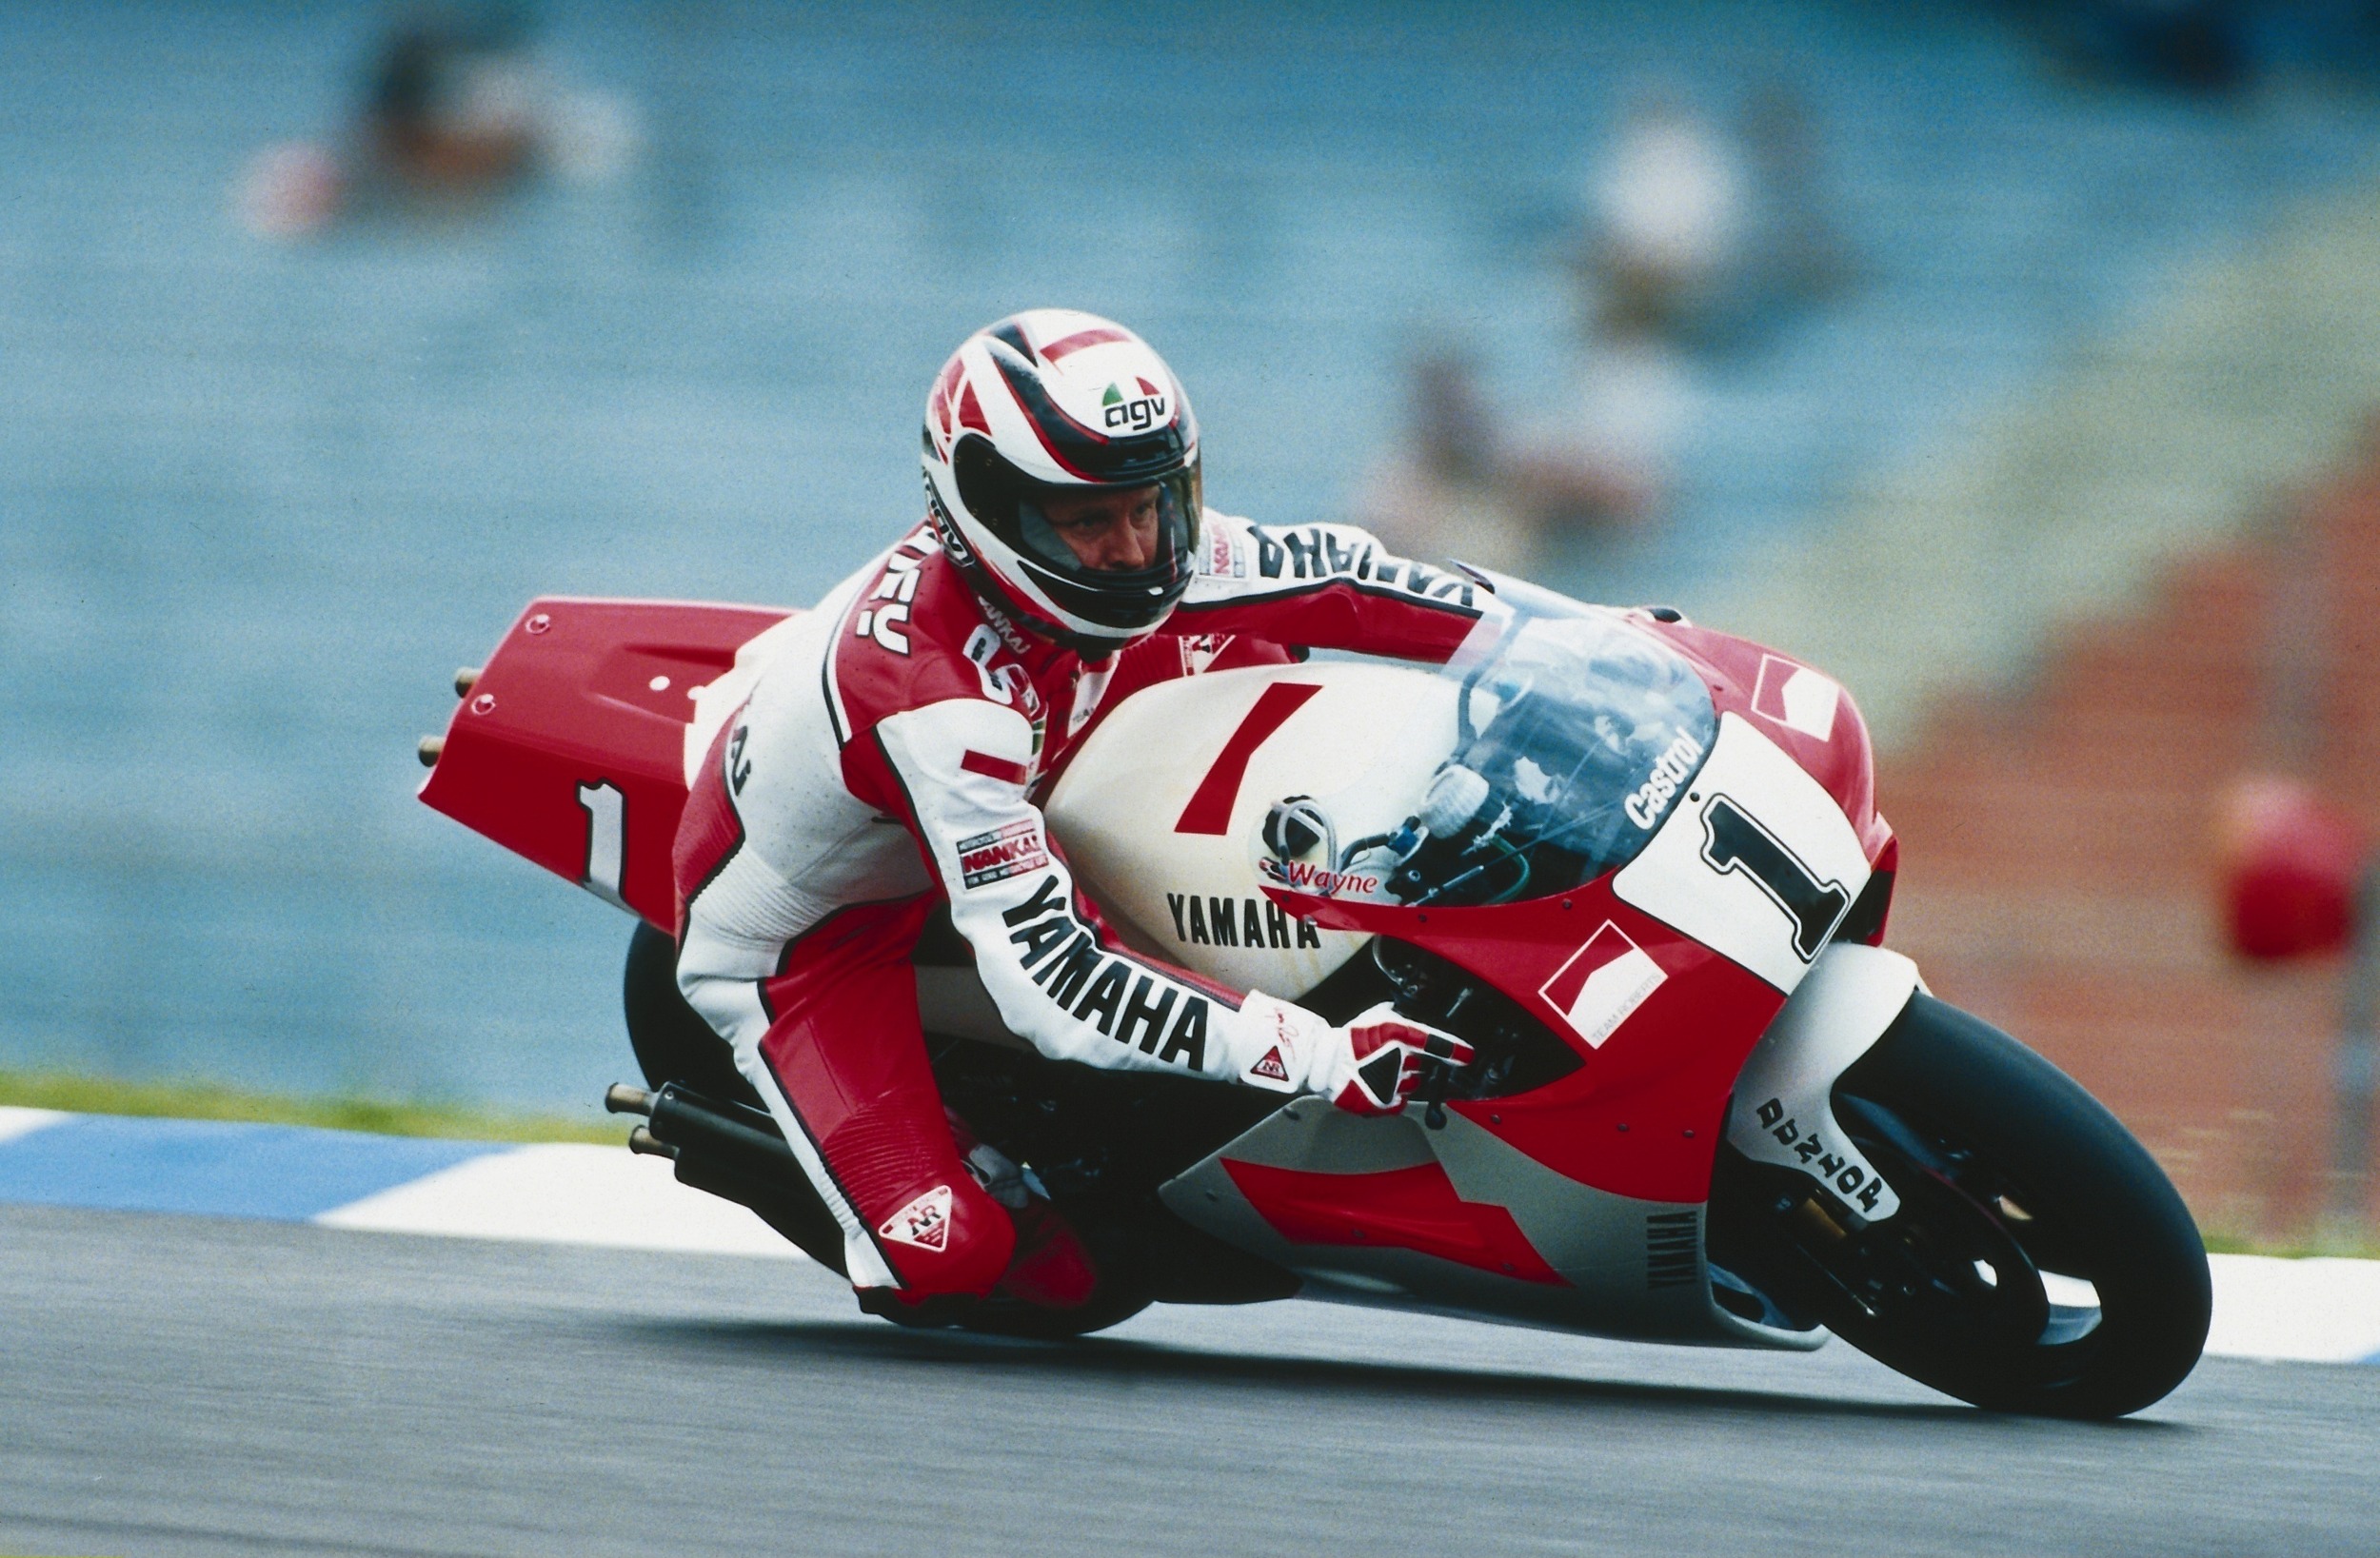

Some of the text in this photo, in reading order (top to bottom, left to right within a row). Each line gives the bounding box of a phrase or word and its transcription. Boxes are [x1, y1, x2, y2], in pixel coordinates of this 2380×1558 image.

[1104, 397, 1165, 431] agv
[1624, 726, 1704, 830] Castrol
[575, 778, 646, 919] 1
[1288, 859, 1378, 895] Wayne
[1700, 793, 1850, 964] 1
[1167, 892, 1321, 949] YAMAHA
[1002, 874, 1209, 1073] YAMAHA
[1755, 1097, 1883, 1213] DUNLOP
[1646, 1210, 1697, 1290] YAMAHA
